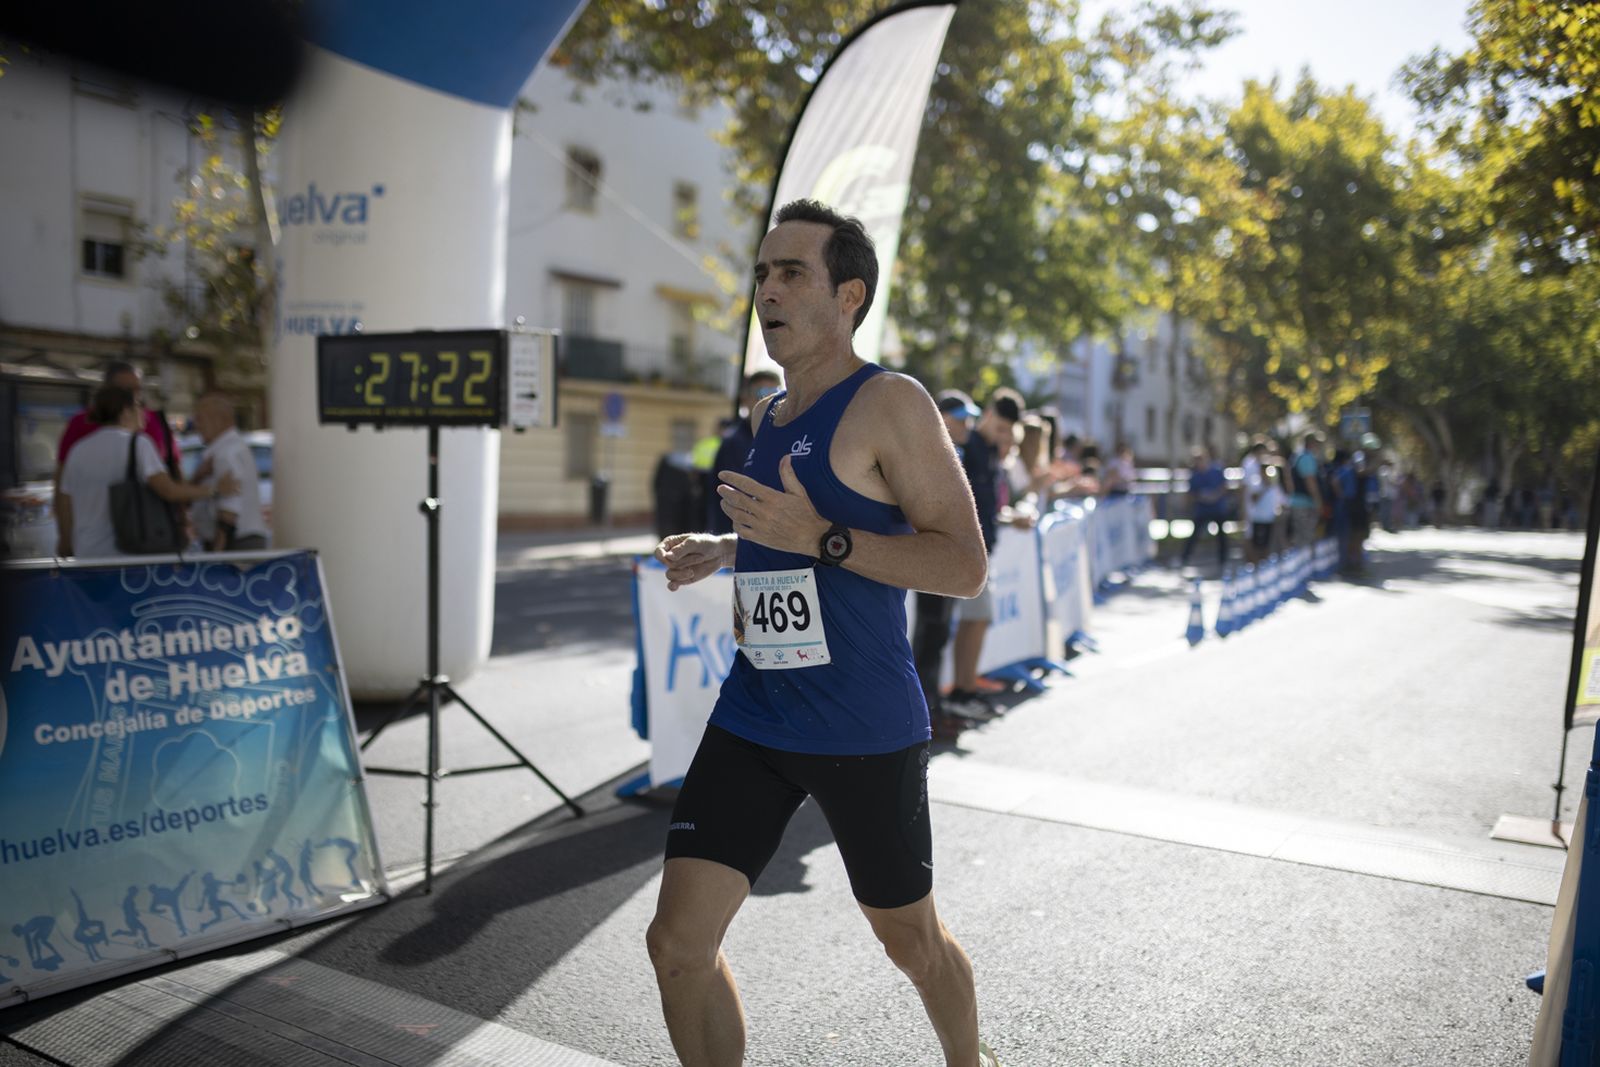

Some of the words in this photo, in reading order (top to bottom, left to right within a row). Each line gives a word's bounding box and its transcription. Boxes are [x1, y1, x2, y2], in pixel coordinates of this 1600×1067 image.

[748, 576, 769, 587] VUELTA
[777, 575, 807, 585] HUELVA
[752, 590, 811, 633] 469
[10, 613, 302, 677] Ayuntamiento
[106, 670, 156, 704] de
[168, 649, 309, 698] Huelva
[34, 707, 169, 746] Concejalía
[174, 703, 204, 727] de
[210, 686, 317, 722] Deportes
[1, 791, 269, 865] huelva.es/deportes
